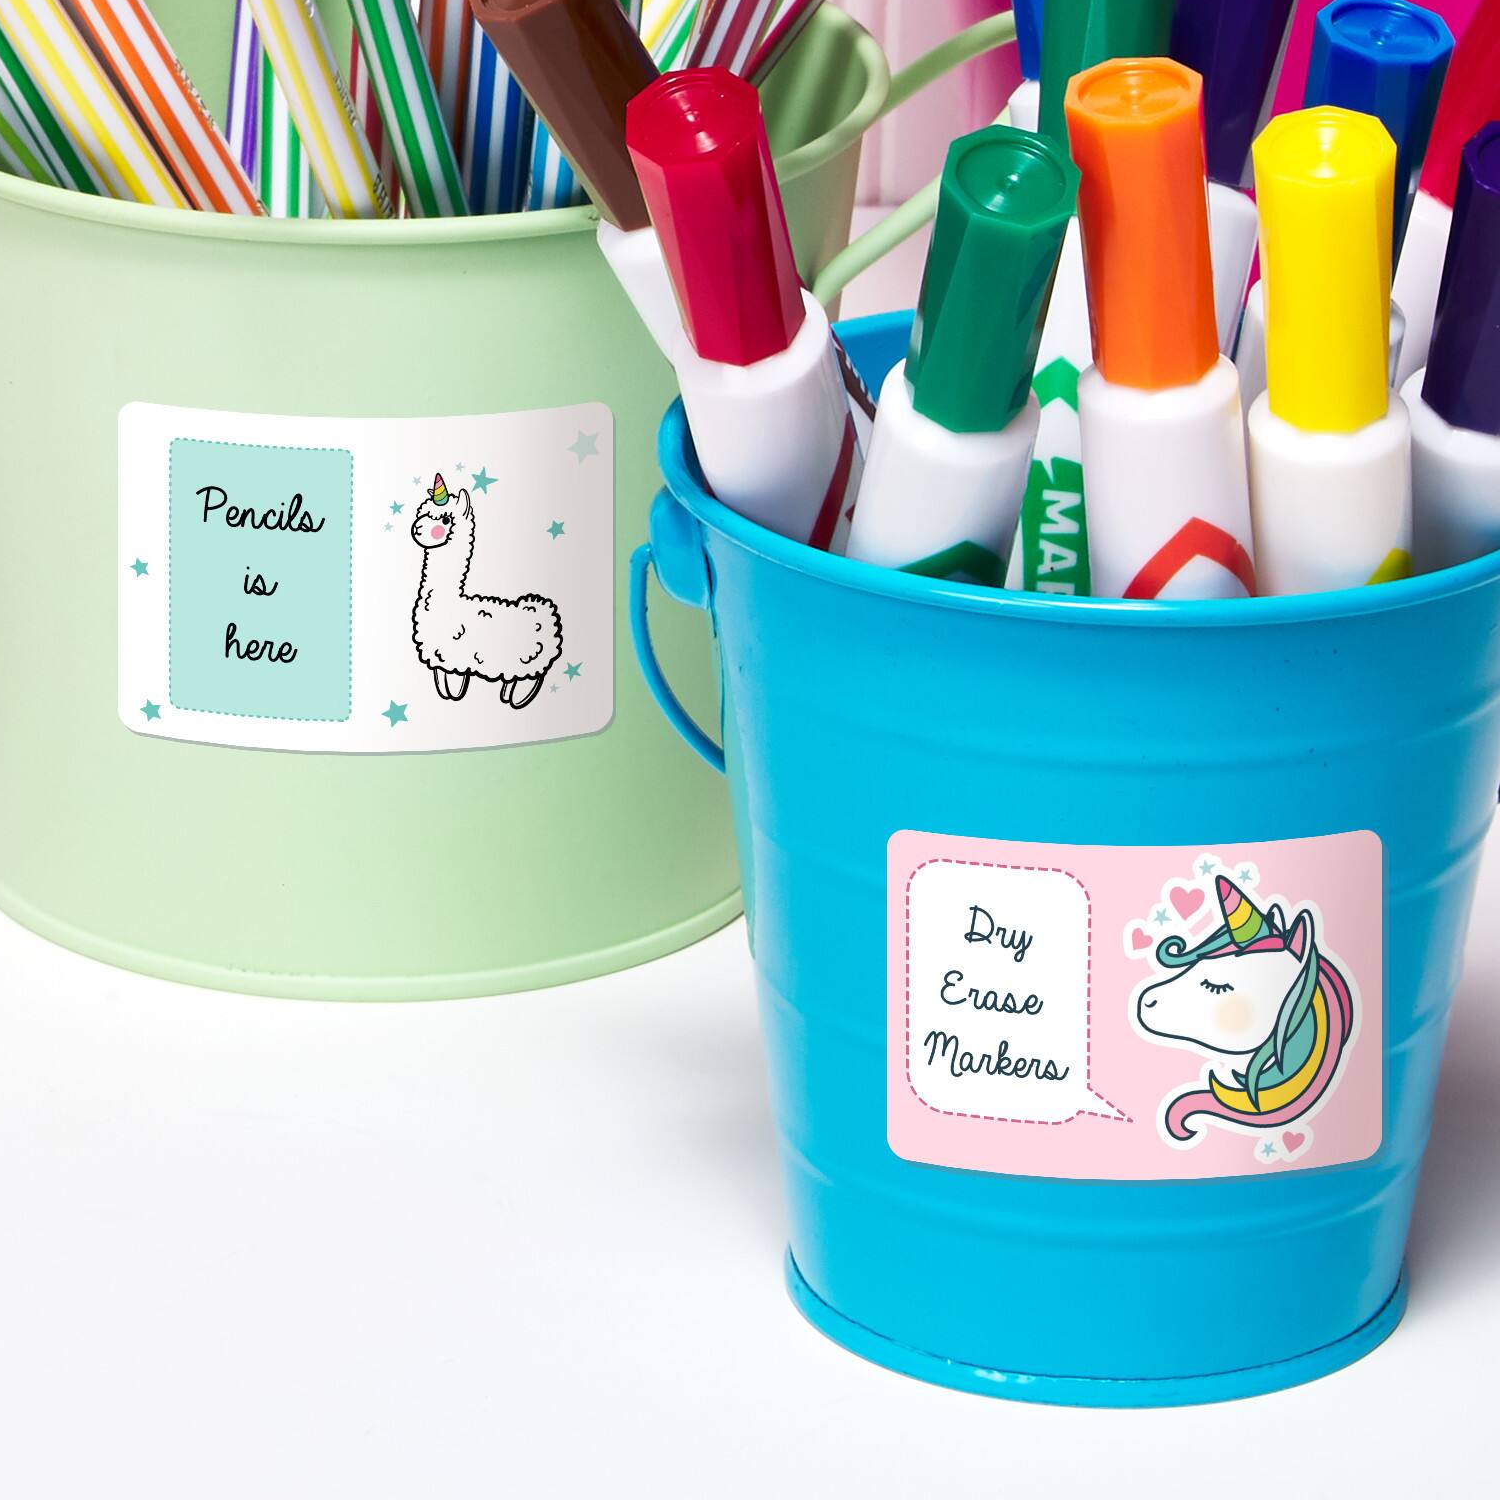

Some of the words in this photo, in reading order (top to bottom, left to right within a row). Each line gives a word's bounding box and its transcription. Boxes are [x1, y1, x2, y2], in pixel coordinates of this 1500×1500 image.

[195, 485, 326, 533] Pencils
[243, 566, 279, 597] is
[224, 622, 298, 664] here
[963, 904, 1033, 963] Dry
[940, 969, 1044, 1016] Erase
[923, 1030, 1070, 1081] Markers
